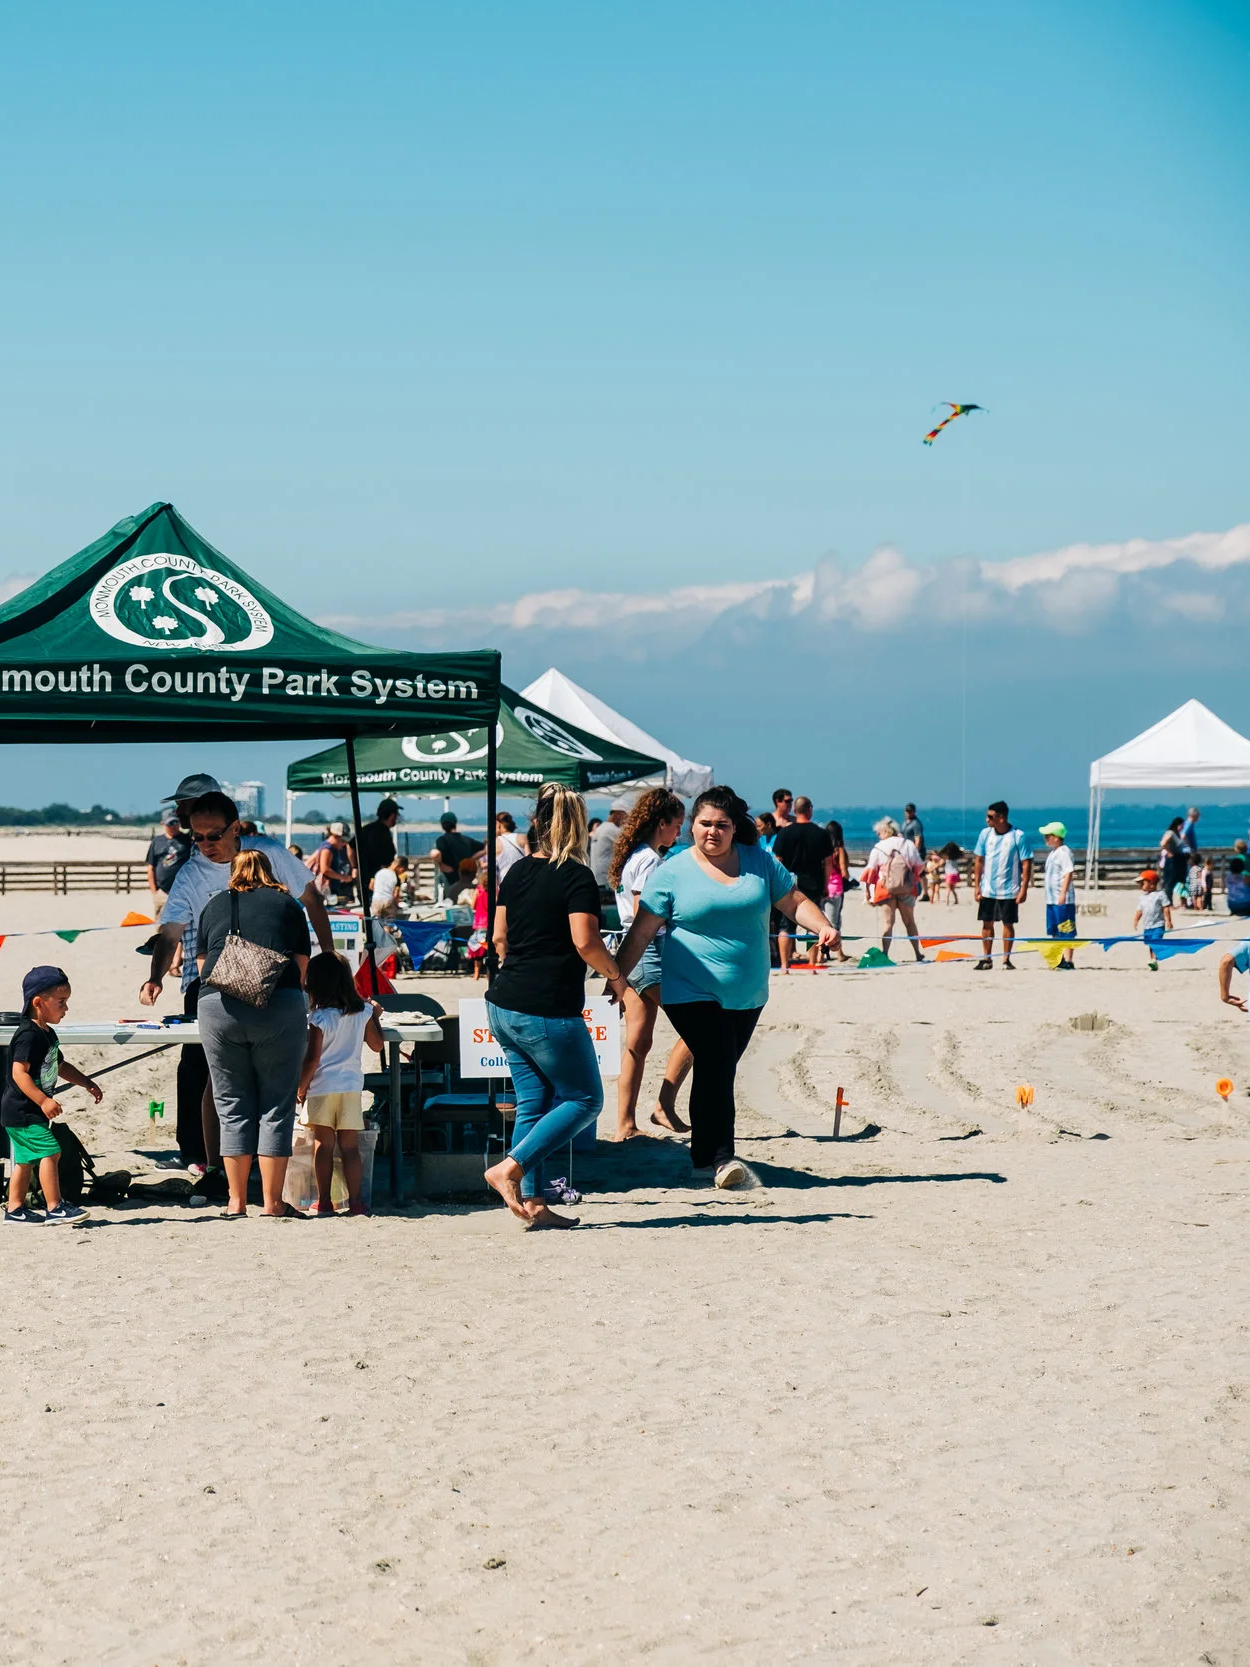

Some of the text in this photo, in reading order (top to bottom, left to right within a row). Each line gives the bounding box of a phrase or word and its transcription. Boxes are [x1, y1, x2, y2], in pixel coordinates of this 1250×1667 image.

[95, 556, 269, 633] MONMOUTH COUNTY PARK SYSTEM
[124, 663, 251, 702] County
[262, 667, 340, 697] Park
[350, 669, 480, 705] System
[399, 767, 451, 784] County
[453, 767, 487, 782] Park
